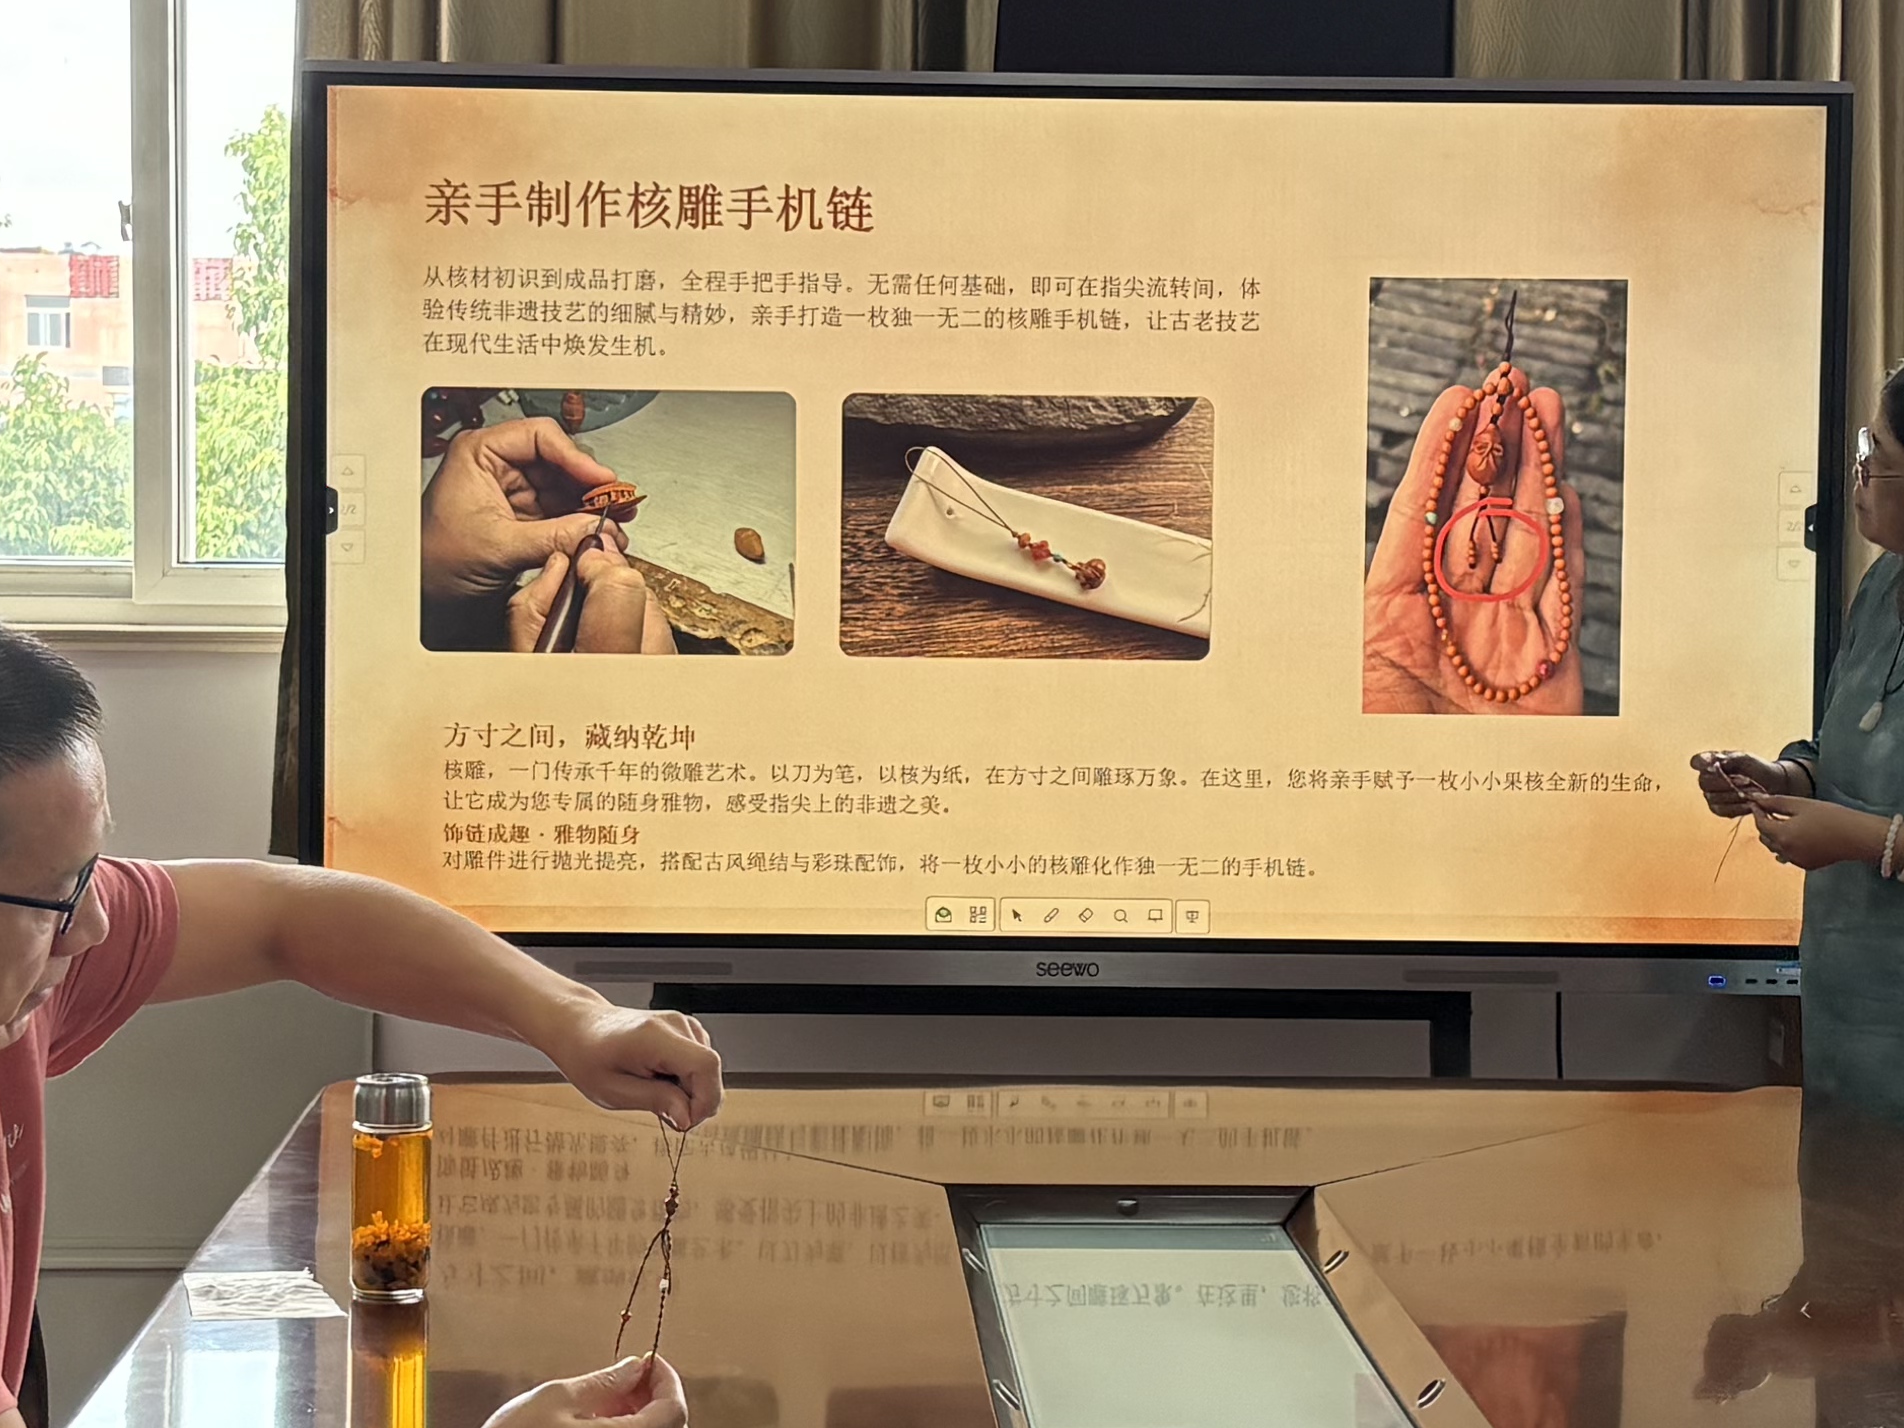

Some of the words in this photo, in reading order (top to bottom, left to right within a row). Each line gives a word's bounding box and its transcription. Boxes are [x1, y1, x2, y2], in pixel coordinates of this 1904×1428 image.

[424, 177, 875, 233] 亲手制作核雕手机链
[421, 332, 668, 358] 在现代生活中焕发生机。
[443, 722, 695, 751] 方寸之间，藏纳乾坤
[1035, 961, 1100, 978] seewo
